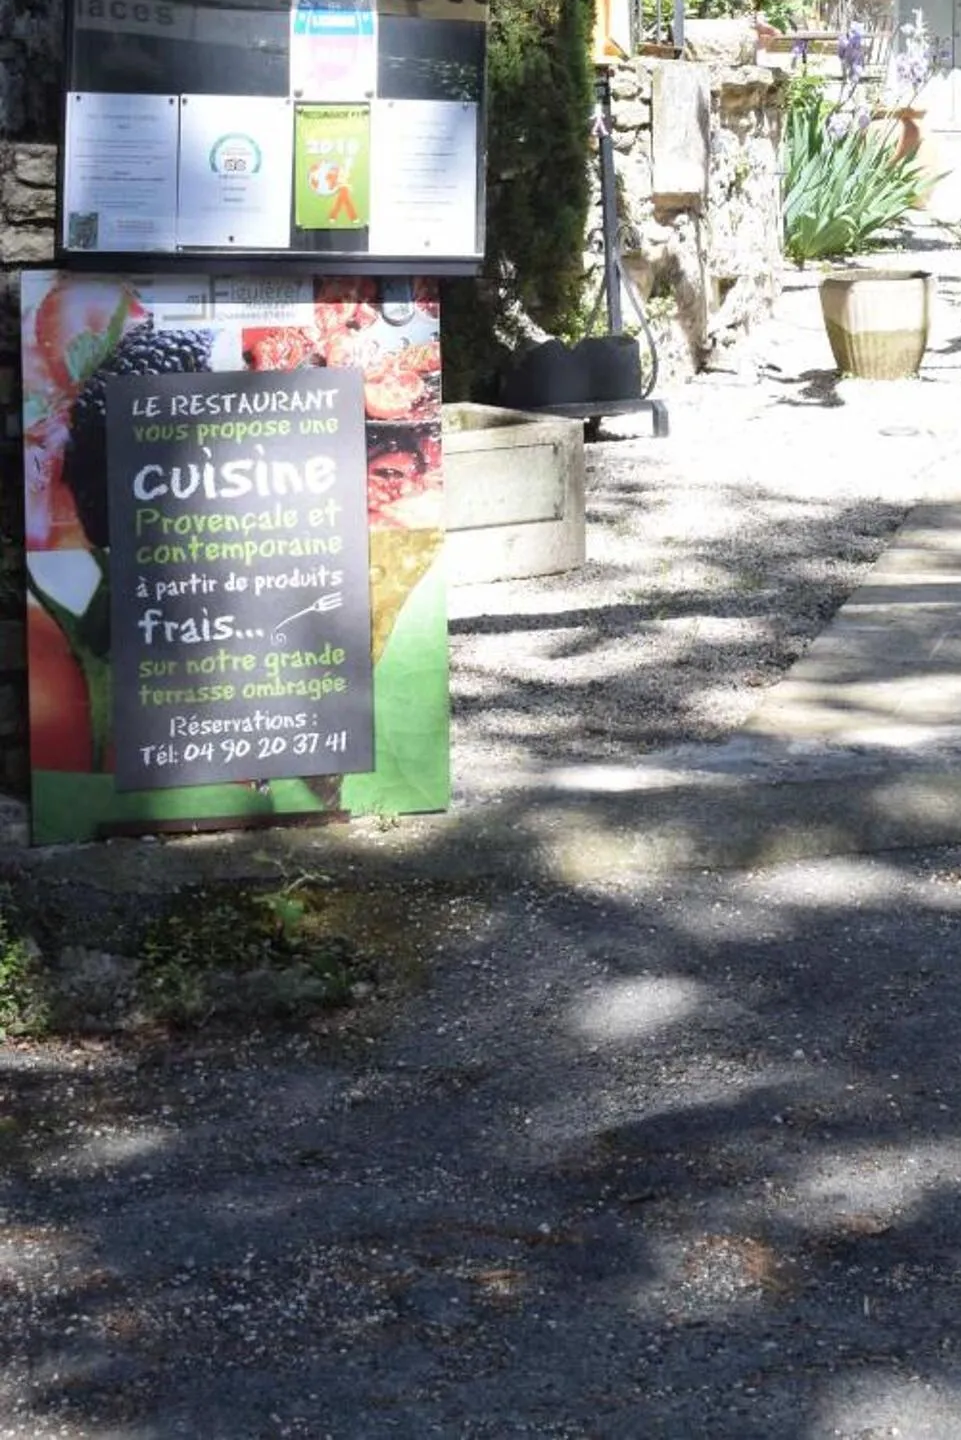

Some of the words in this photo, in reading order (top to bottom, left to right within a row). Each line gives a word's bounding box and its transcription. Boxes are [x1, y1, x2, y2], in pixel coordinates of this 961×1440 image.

[132, 394, 161, 417] LE
[171, 388, 340, 416] RESTAURANT
[132, 420, 190, 442] vous
[197, 417, 292, 444] propose
[299, 417, 339, 436] une
[135, 500, 299, 538] Provençale
[308, 499, 343, 526] et
[135, 533, 343, 566] contemporaine
[136, 575, 150, 599] à
[156, 572, 218, 601] partir
[223, 571, 250, 592] de
[255, 566, 344, 596] produits
[137, 607, 265, 645] frais...
[139, 659, 176, 679] sur
[186, 652, 256, 676] notre
[264, 646, 346, 677] grande
[138, 679, 235, 708] terrasse
[242, 672, 348, 702] ombragée
[140, 744, 181, 767] Tél:
[184, 744, 216, 763] 04
[223, 740, 250, 764] 90
[258, 736, 286, 757] 20
[293, 732, 320, 755] 37
[325, 730, 348, 753] 41
